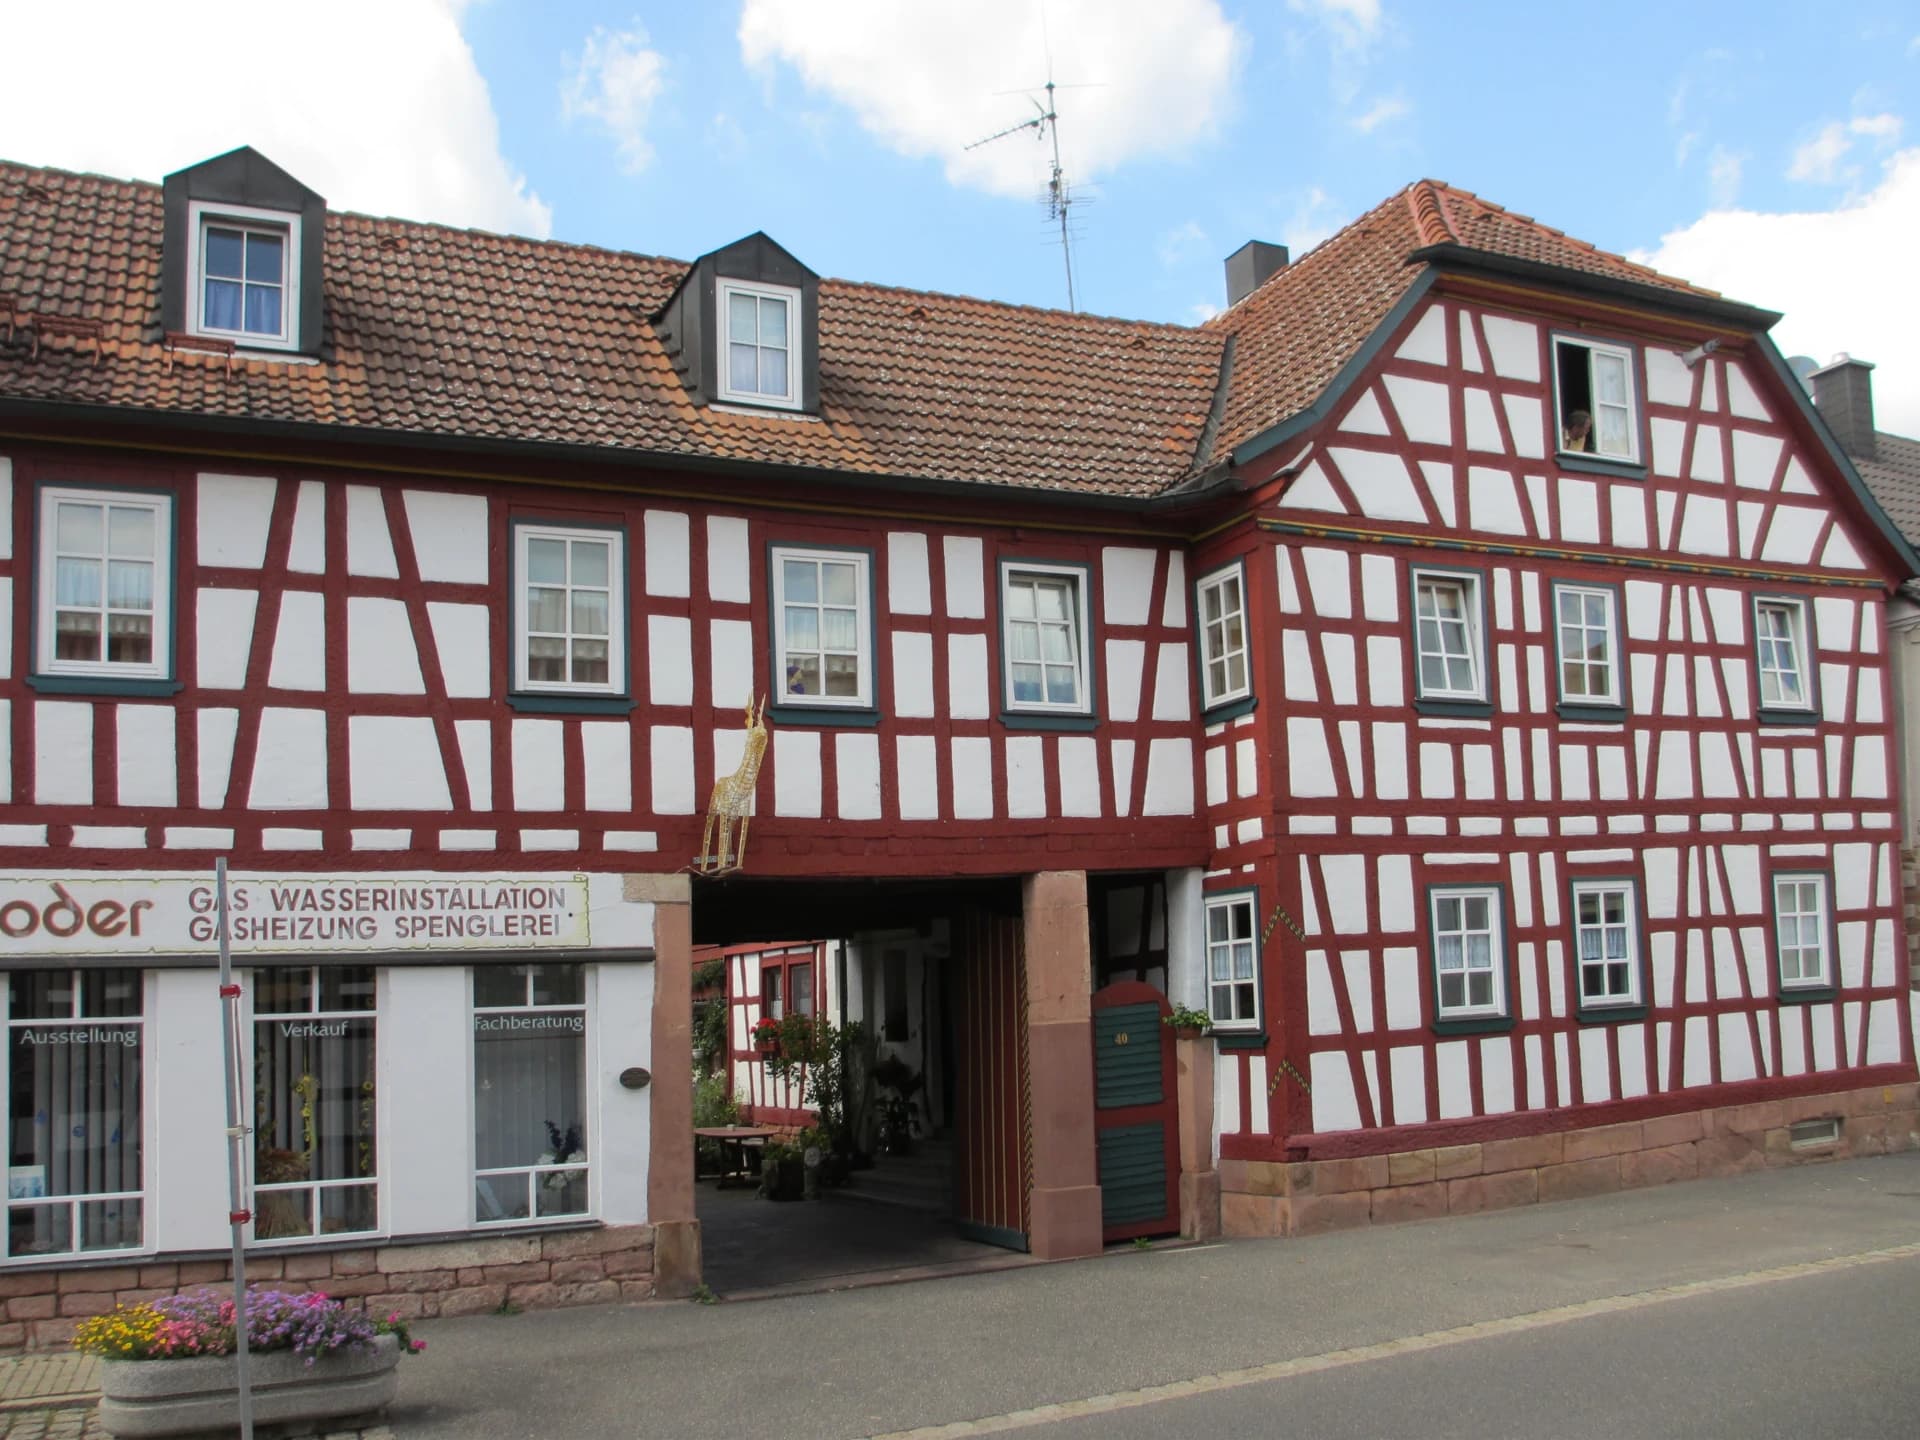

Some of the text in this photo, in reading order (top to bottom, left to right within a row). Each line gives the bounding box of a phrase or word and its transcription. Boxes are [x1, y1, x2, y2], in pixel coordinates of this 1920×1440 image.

[270, 887, 566, 912] WASSERINSTALLATION
[394, 914, 560, 939] SPENGLEREI
[280, 1020, 350, 1038] Verkauf
[474, 1015, 585, 1032] Fachberatung
[19, 1027, 138, 1048] Ausstellung
